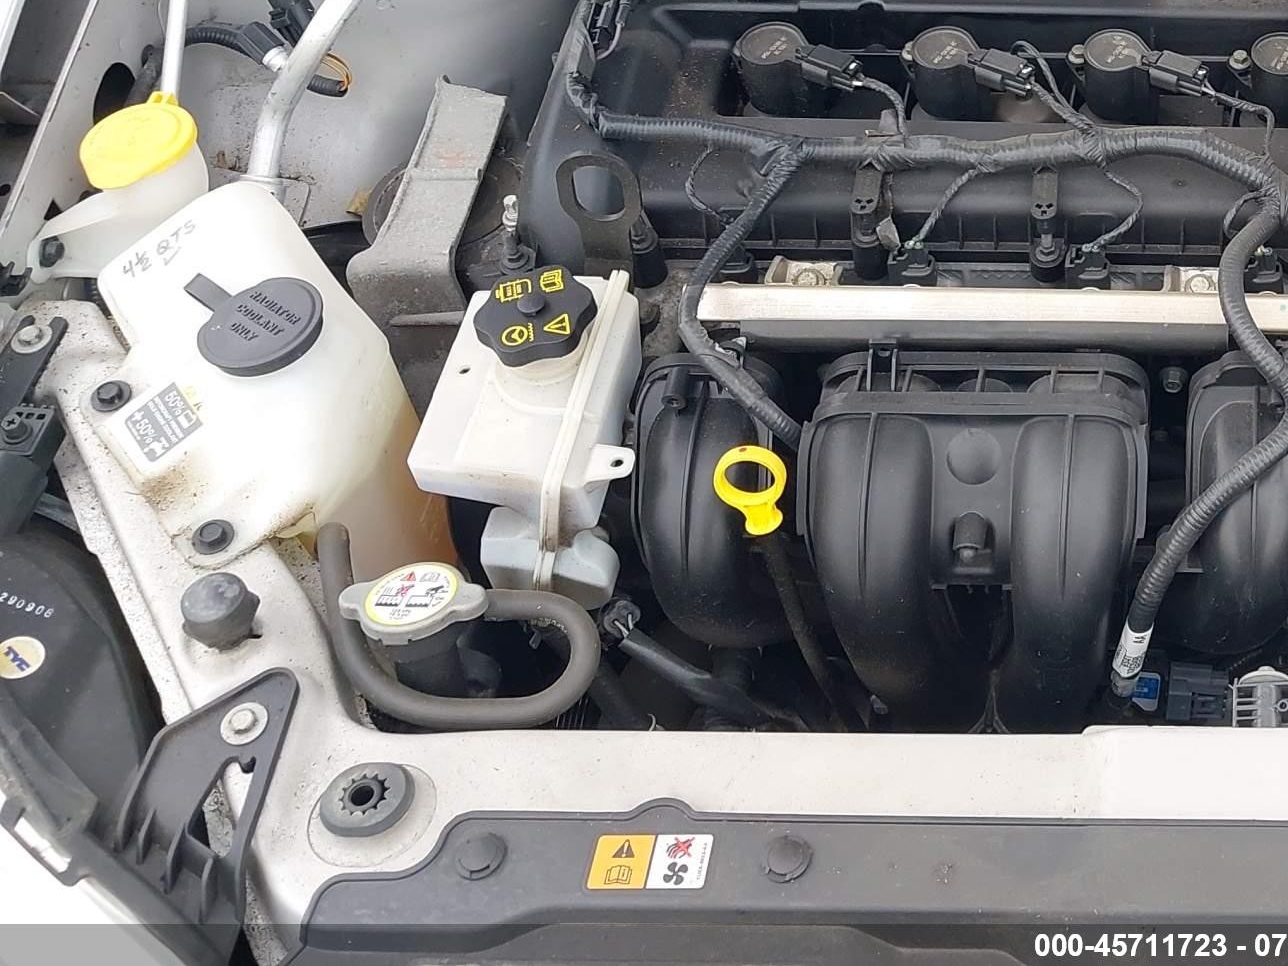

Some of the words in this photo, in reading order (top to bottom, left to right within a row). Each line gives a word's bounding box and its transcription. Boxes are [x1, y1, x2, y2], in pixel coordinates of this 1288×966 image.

[156, 220, 196, 255] QTS
[236, 304, 285, 336] COOLANT
[250, 291, 301, 326] RADIATOR
[230, 322, 259, 342] ONLY
